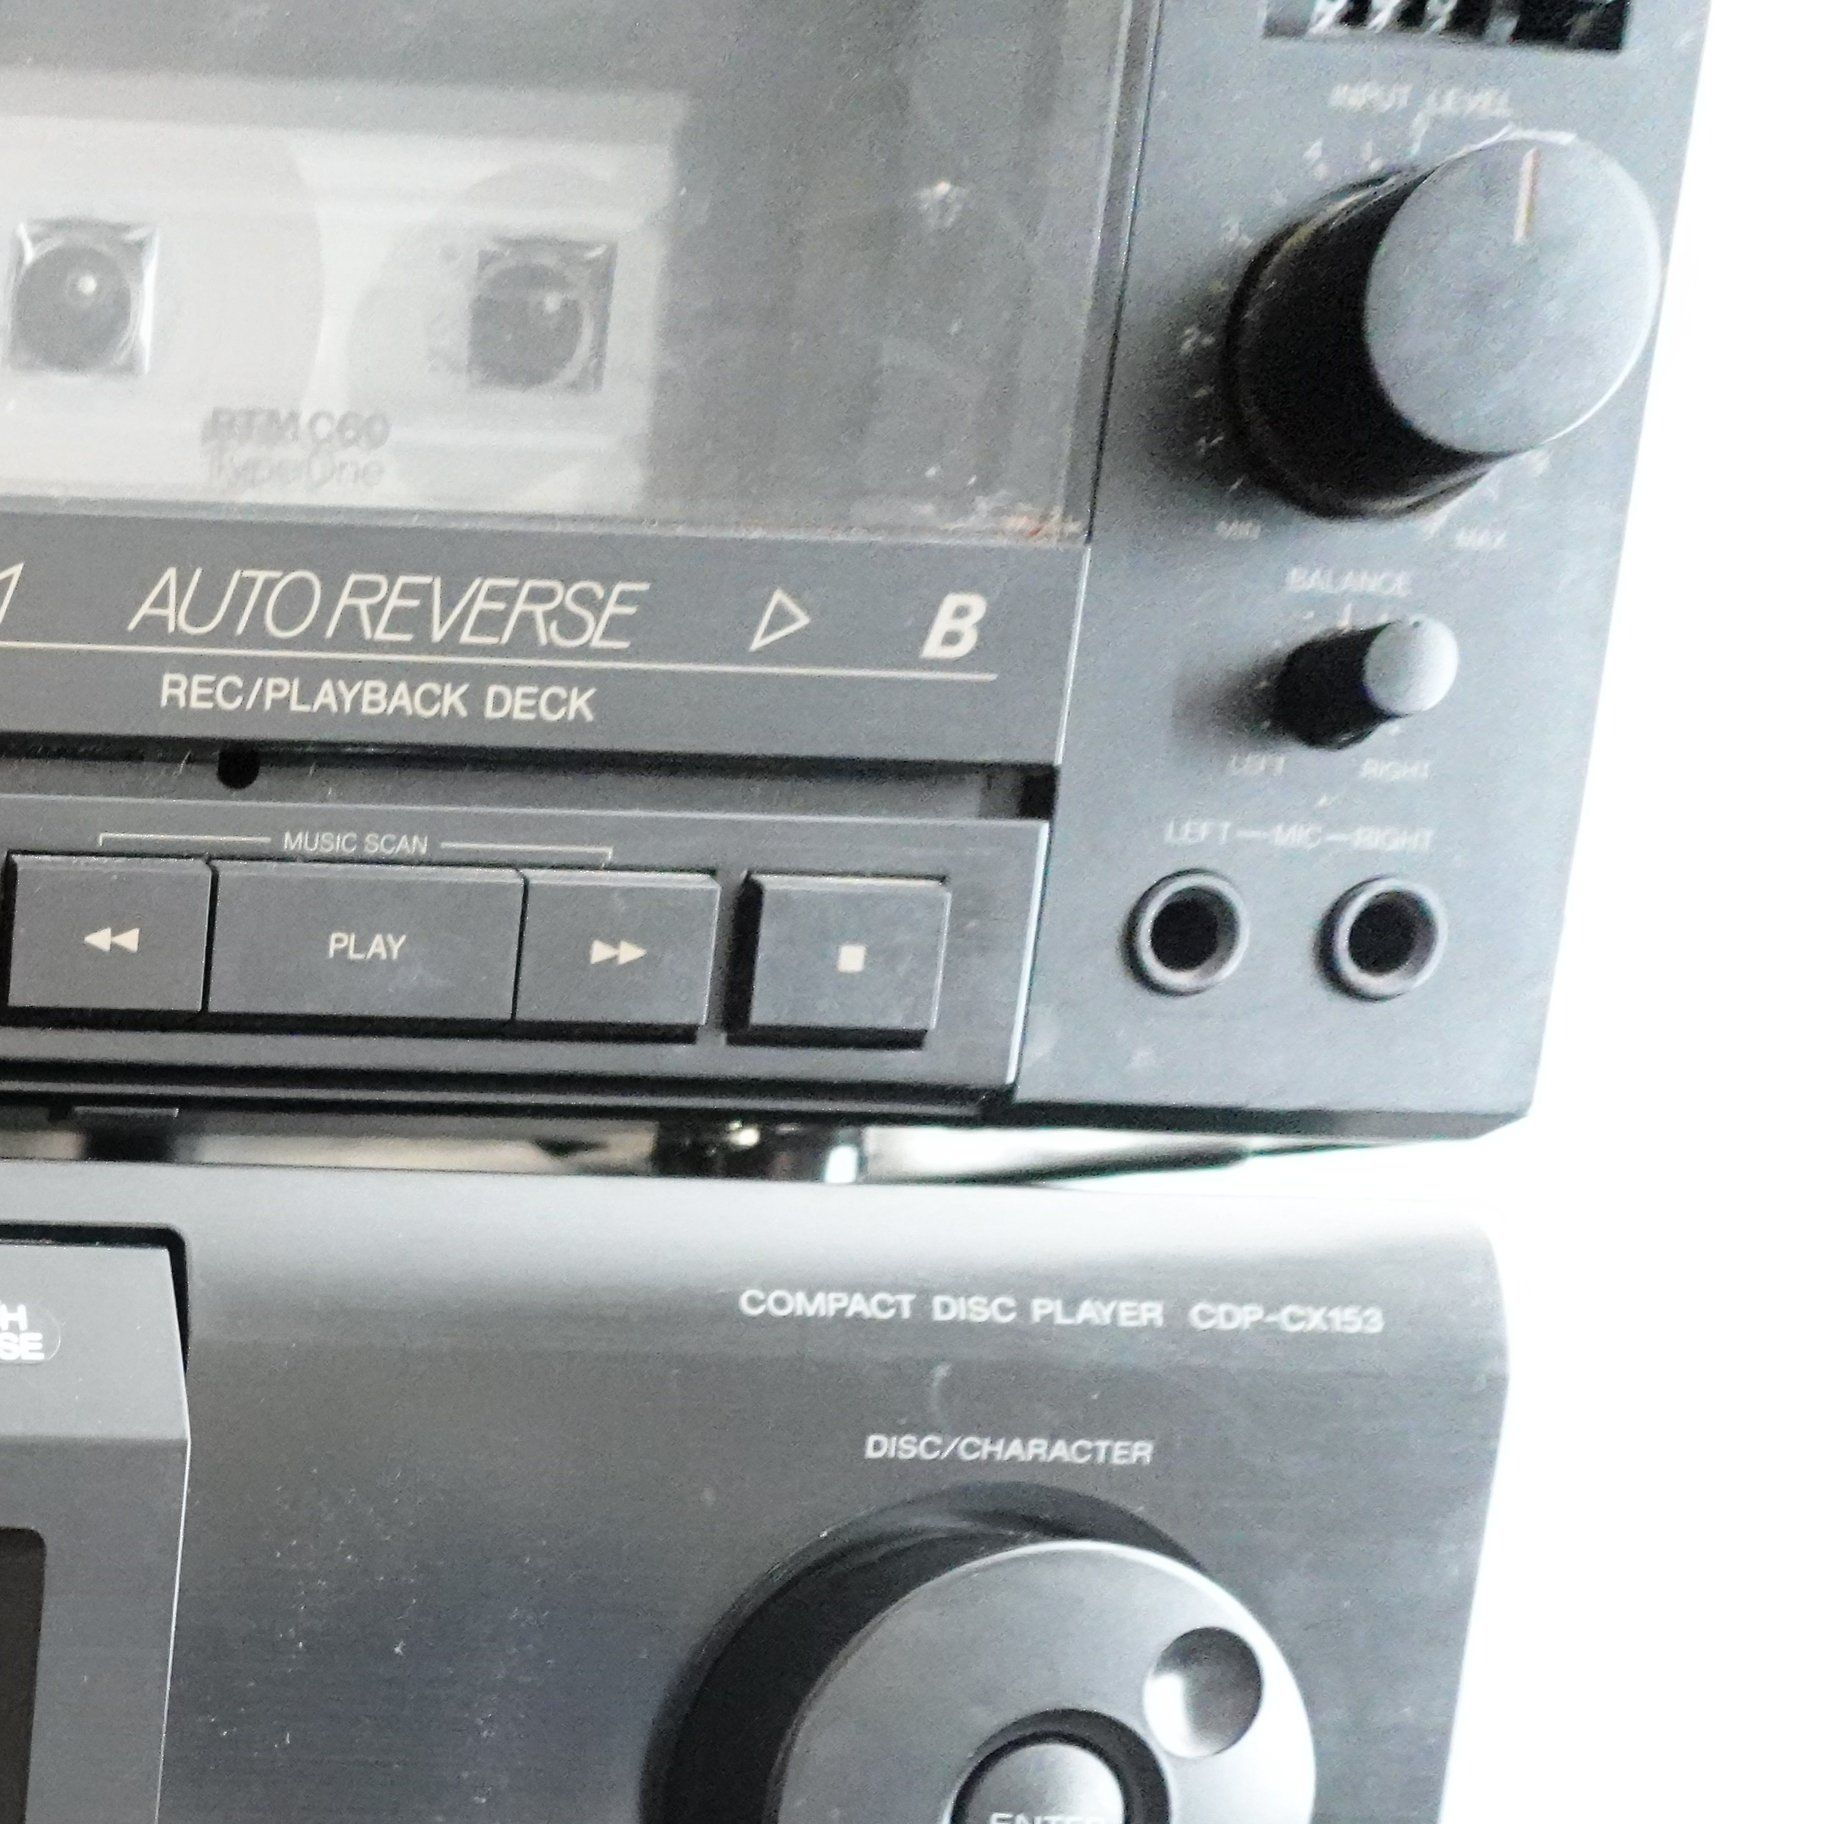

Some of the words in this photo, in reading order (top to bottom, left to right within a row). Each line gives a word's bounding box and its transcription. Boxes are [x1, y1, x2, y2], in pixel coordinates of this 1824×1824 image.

[1287, 567, 1411, 598] BALANCE
[126, 566, 320, 638] AUTO
[328, 574, 650, 650] REVERSE
[922, 594, 984, 660] B
[160, 675, 468, 718] REC/PLAYBACK
[483, 683, 596, 722] DECK
[283, 829, 357, 855] MUSIC
[364, 831, 428, 858] SCAN
[1163, 818, 1232, 845] LEFT
[1273, 824, 1323, 848] MIC
[1351, 826, 1434, 852] RIGHT
[328, 931, 405, 963] PLAY
[741, 1289, 914, 1321] COMPACT
[932, 1296, 1016, 1323] DISC
[1032, 1299, 1164, 1328] PLAYER
[1190, 1302, 1383, 1333] CDP-CX153
[865, 1434, 1154, 1466] DISC/CHARACTER
